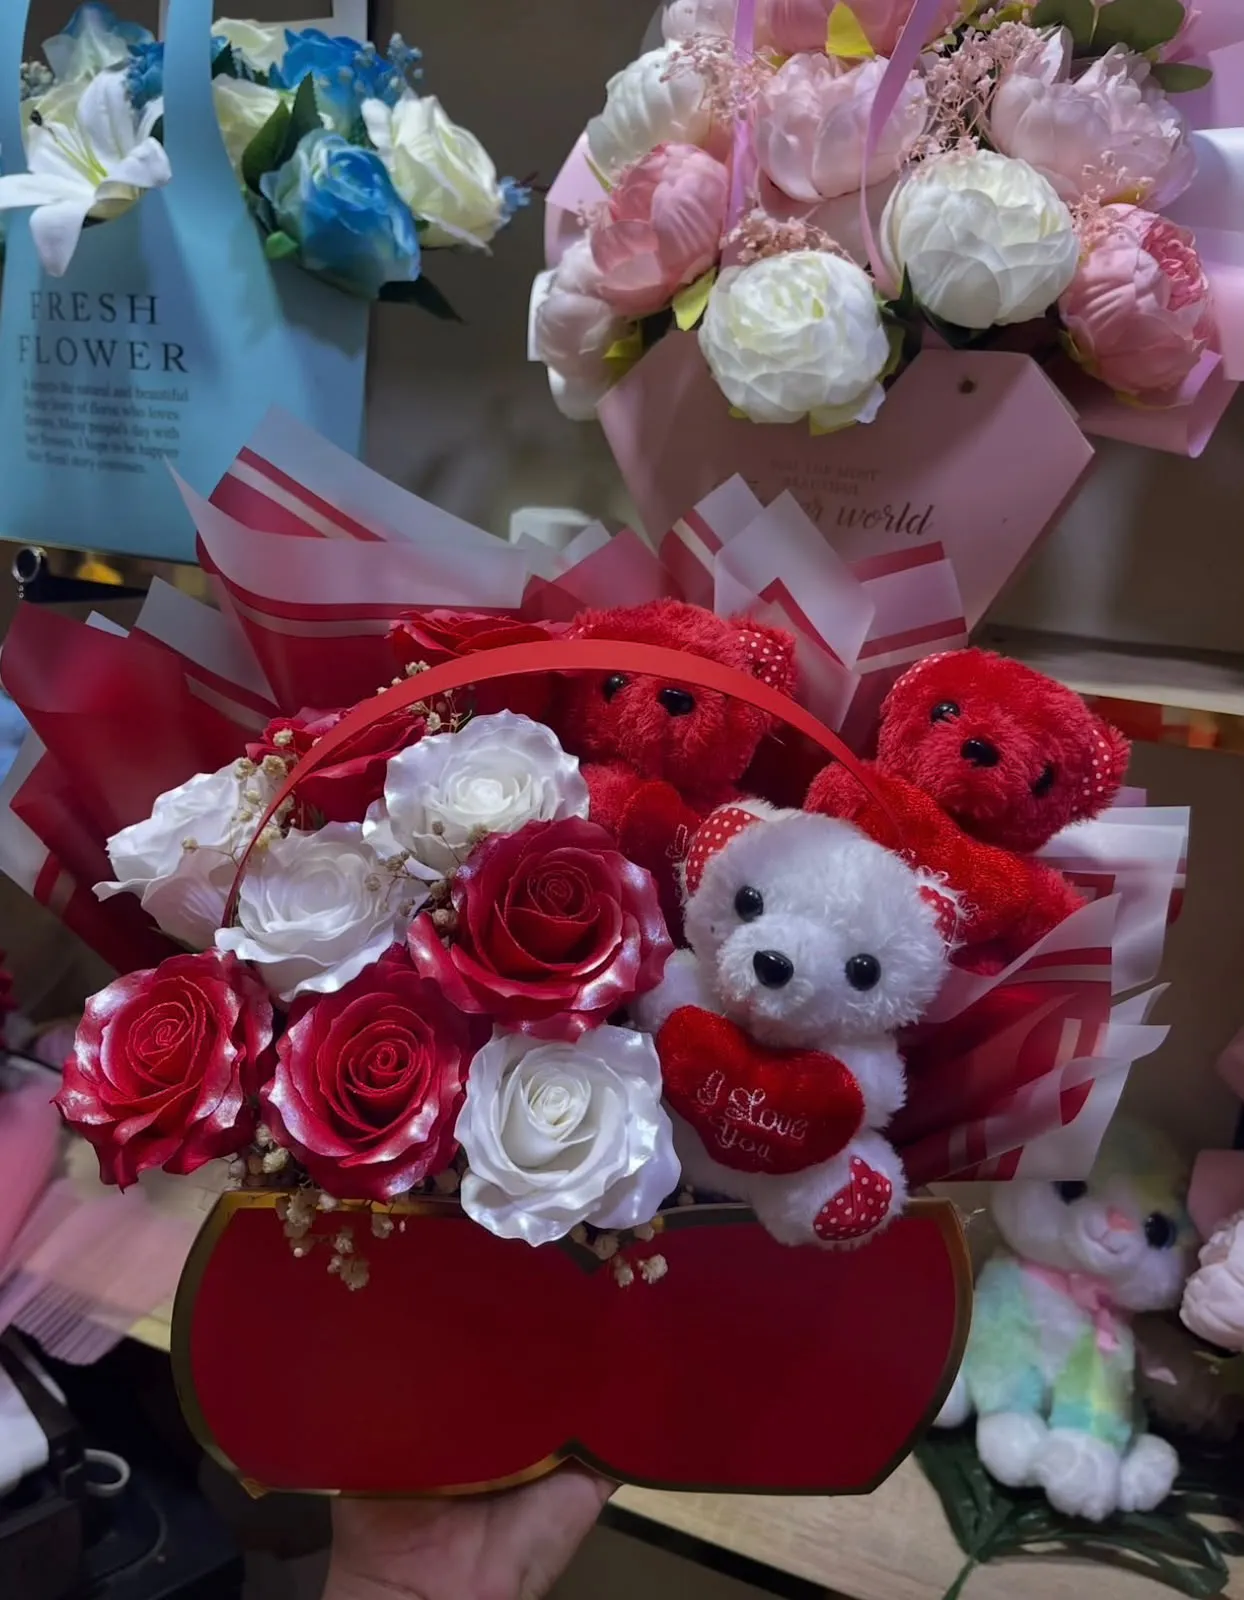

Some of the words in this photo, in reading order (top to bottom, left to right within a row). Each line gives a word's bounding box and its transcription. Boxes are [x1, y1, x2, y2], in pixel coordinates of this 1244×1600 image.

[29, 291, 160, 325] FRESH
[18, 335, 189, 373] FLOWER
[836, 502, 936, 536] world
[725, 1087, 809, 1140] Love
[708, 1115, 772, 1160] You
